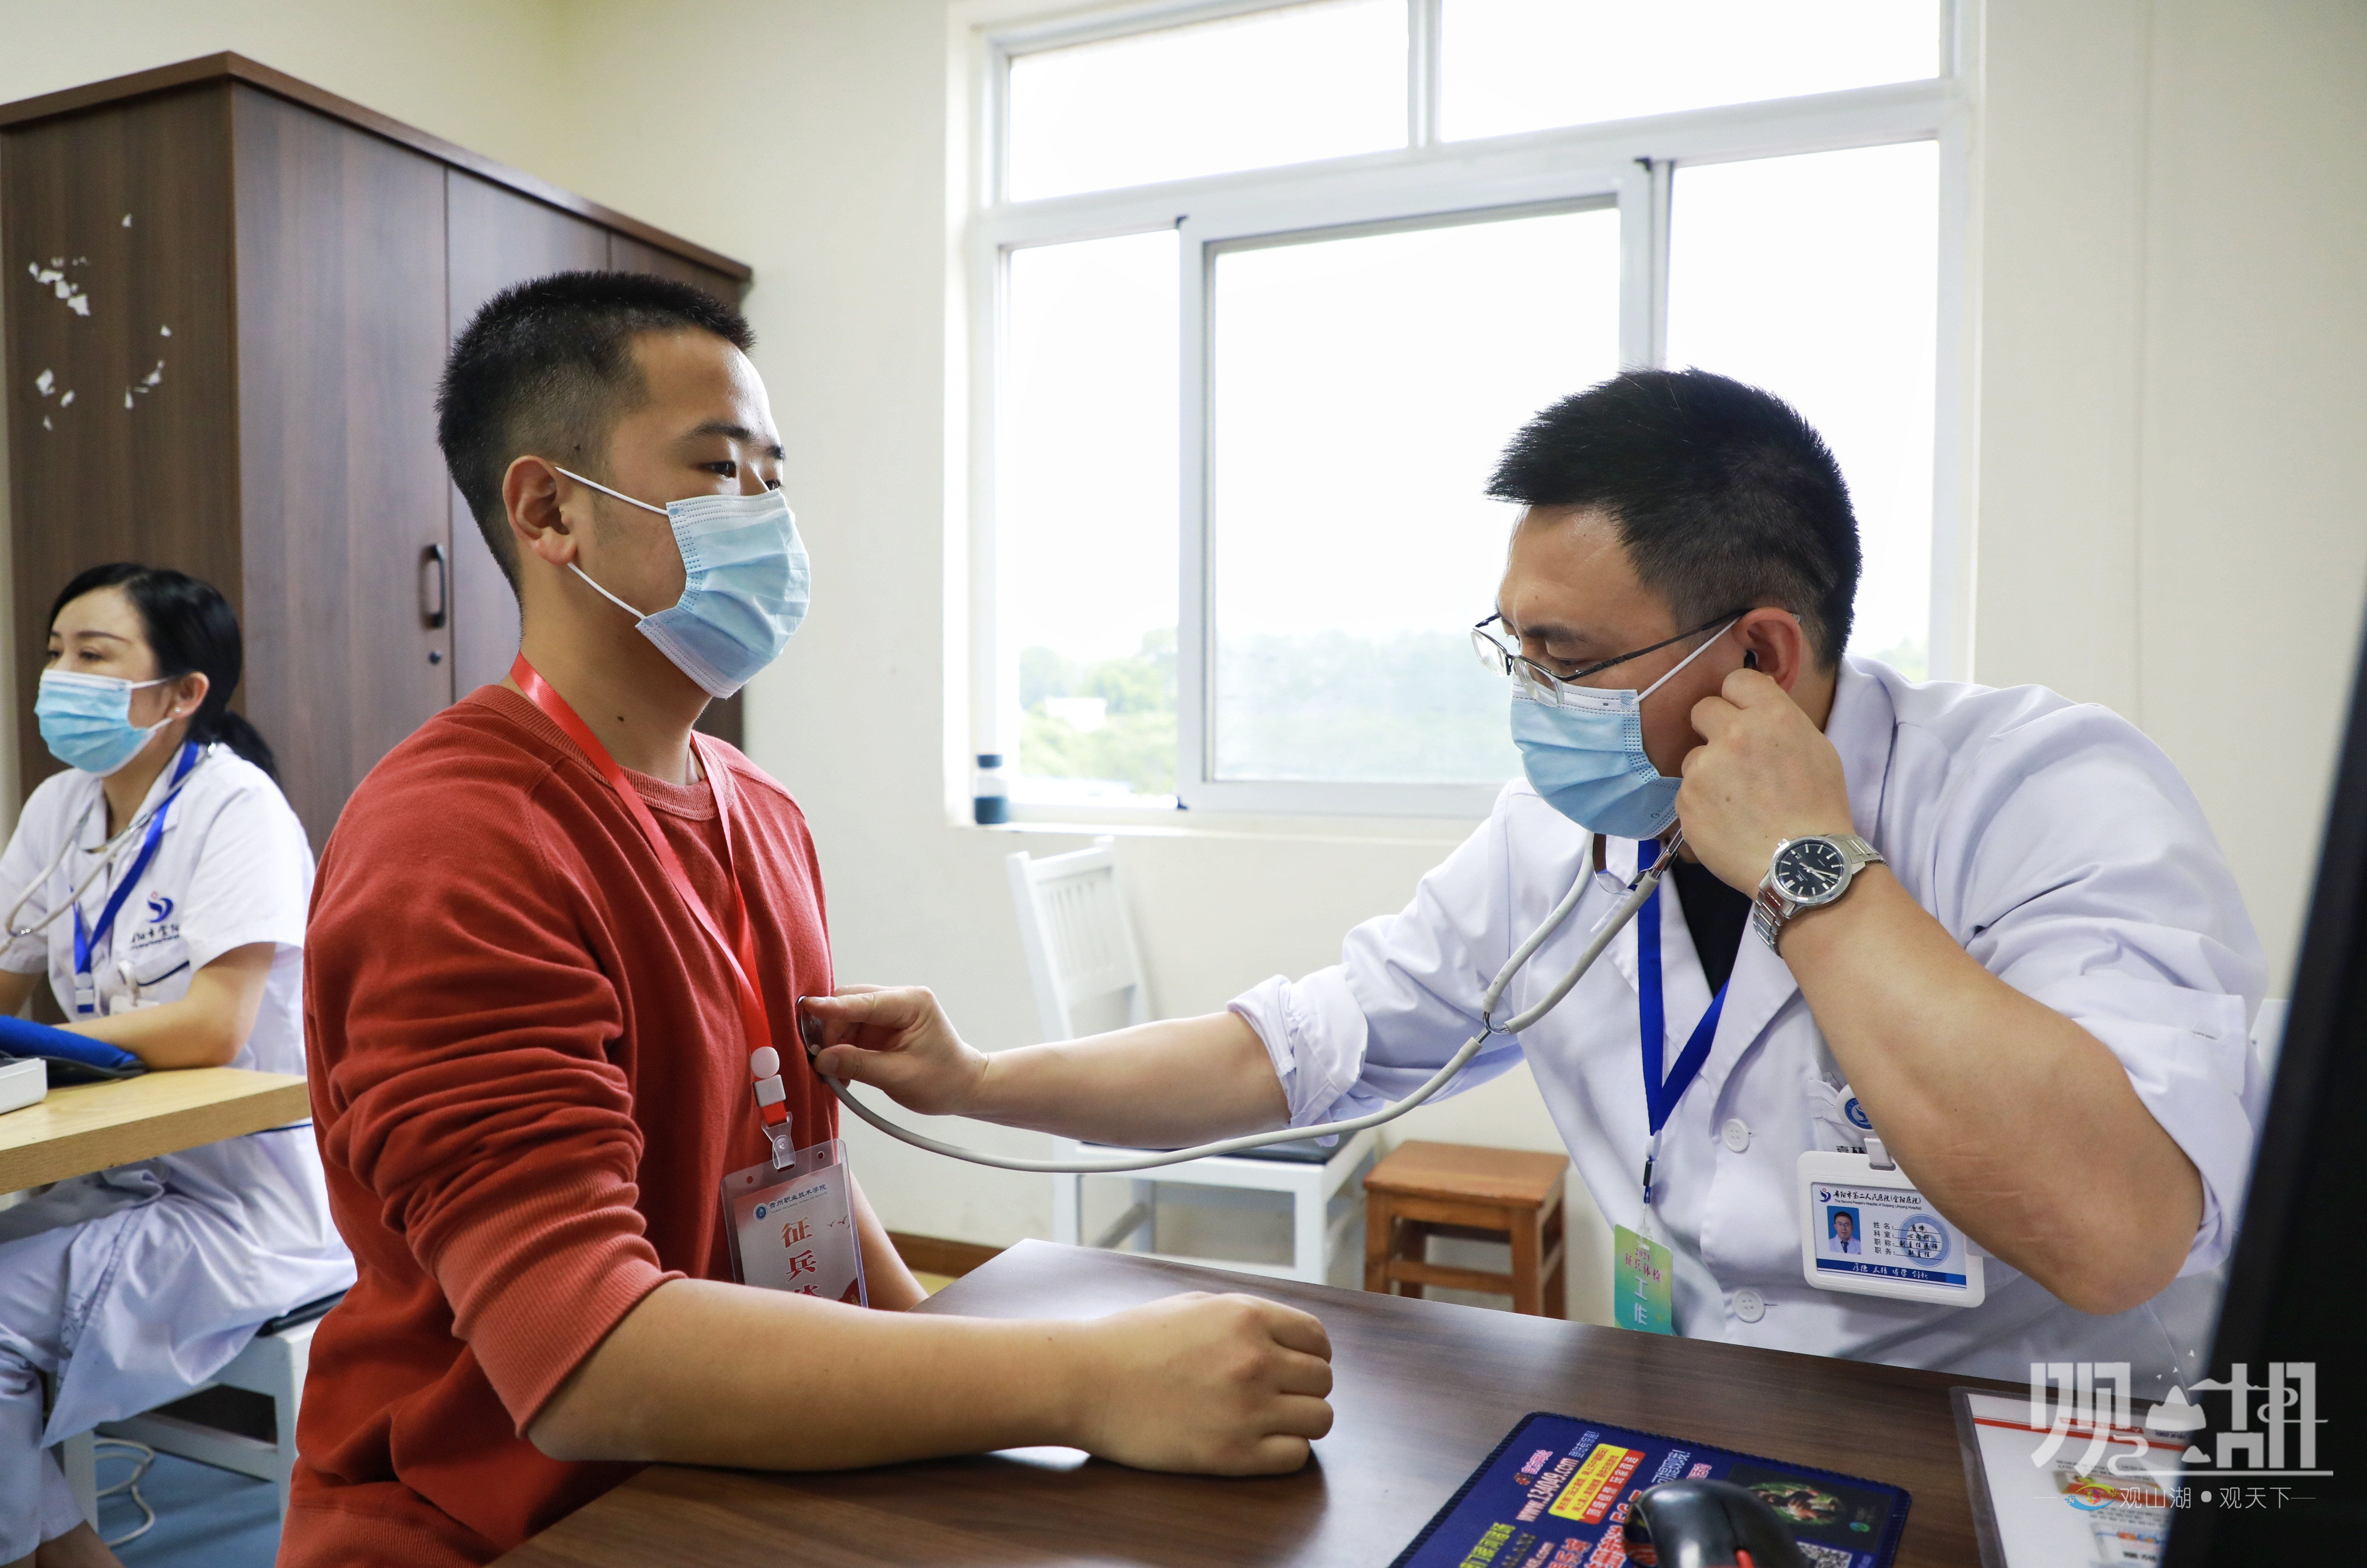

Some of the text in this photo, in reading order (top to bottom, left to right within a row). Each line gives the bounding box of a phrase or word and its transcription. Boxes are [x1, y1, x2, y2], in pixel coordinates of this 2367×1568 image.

[769, 1184, 826, 1209] 贵州职业技术学院
[1874, 1230, 1895, 1238] 科室:
[1874, 1238, 1895, 1247] 职称:
[1635, 1247, 1650, 1262] 2021
[1874, 1247, 1895, 1255] 职务:
[1516, 1457, 1579, 1522] www.134049.com
